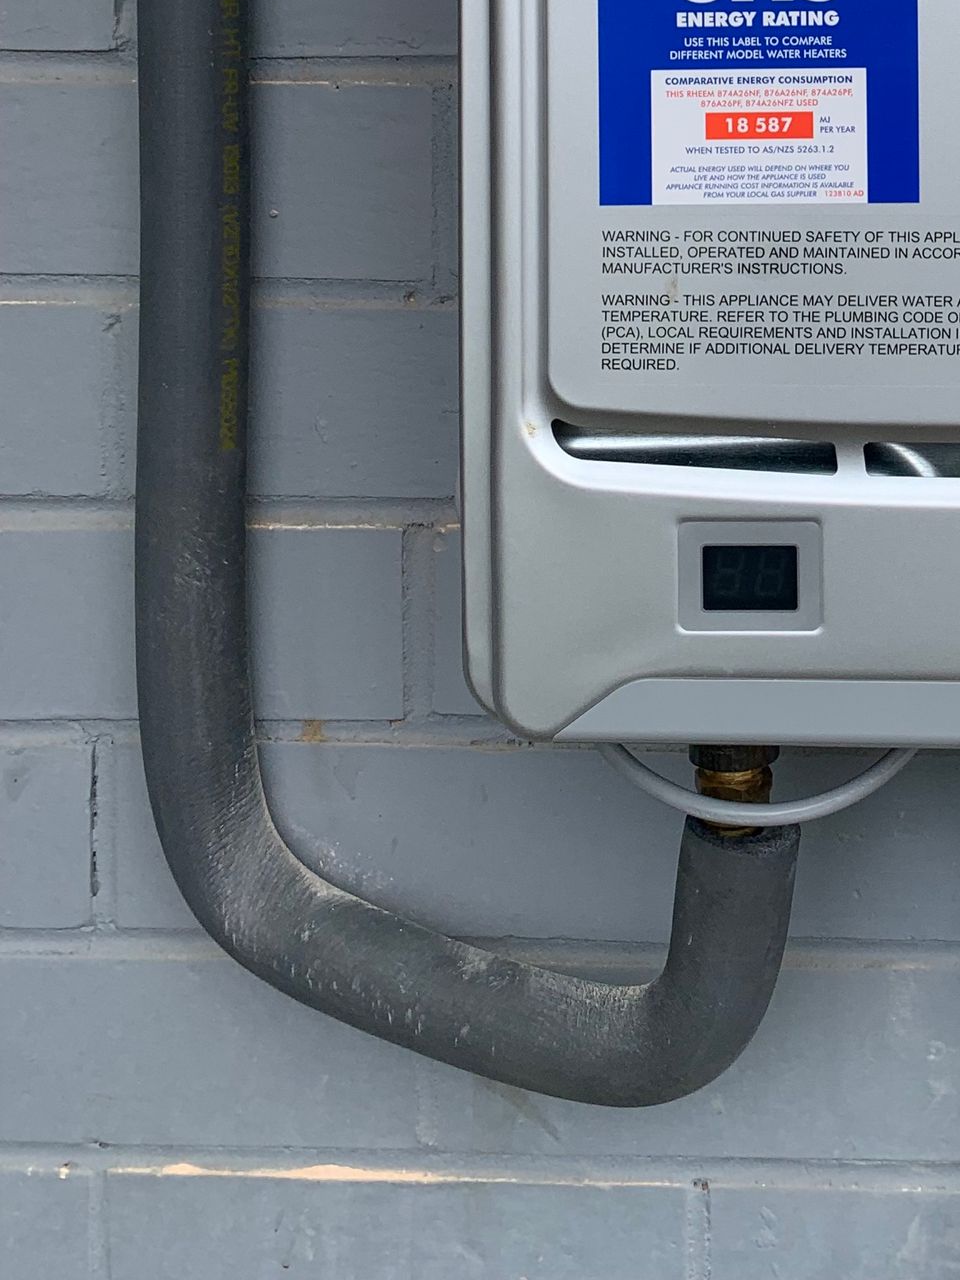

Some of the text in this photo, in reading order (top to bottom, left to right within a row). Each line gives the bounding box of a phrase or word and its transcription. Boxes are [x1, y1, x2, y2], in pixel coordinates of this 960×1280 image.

[676, 10, 839, 27] ENERGY RATING
[684, 36, 832, 48] USE THIS LABEL TO COMPARE
[669, 48, 847, 59] DIFFERENT MODEL WATER HEATERS
[665, 75, 852, 85] COMPARATIVE ENERGY CONSUMPTION
[666, 90, 684, 98] THIS
[725, 117, 792, 132] 18 587
[820, 125, 855, 133] PER YEAR
[685, 146, 712, 154] WHEN
[714, 146, 745, 154] TESTED
[761, 145, 794, 153] AS/NZS
[797, 145, 834, 153] 5263.1.2
[602, 230, 670, 242] WARNING
[684, 230, 713, 242] FOR
[717, 230, 801, 242] CONTINUED
[805, 230, 860, 242] SAFETY
[864, 230, 883, 242] OF
[888, 231, 920, 243] THIS
[602, 246, 682, 259] INSTALLED,
[687, 246, 765, 258] OPERATED
[768, 246, 799, 258] AND
[803, 246, 890, 258] MAINTAINED
[895, 247, 908, 258] IN
[602, 262, 846, 274] MANUFACTURER'S INSTRUCTIONS.
[601, 294, 670, 306] WARNING
[682, 294, 715, 306] THIS
[718, 294, 798, 306] APPLIANCE
[803, 294, 833, 306] MAY
[837, 294, 897, 307] DELIVER
[901, 295, 953, 307] WATER
[601, 310, 712, 322] TEMPERATURE.
[717, 310, 764, 322] REFER
[768, 310, 788, 322] TO
[792, 310, 820, 322] THE
[824, 311, 898, 323] PLUMBING
[902, 311, 943, 323] CODE
[601, 326, 643, 340] (PCA),
[648, 326, 694, 338] LOCAL
[698, 326, 812, 338] REQUIREMENTS
[816, 327, 846, 338] AND
[851, 327, 951, 339] INSTALLATION
[601, 342, 684, 354] DETERMINE
[689, 342, 701, 354] IF
[704, 342, 790, 354] ADDITIONAL
[794, 342, 864, 355] DELIVERY
[601, 358, 679, 370] REQUIRED.
